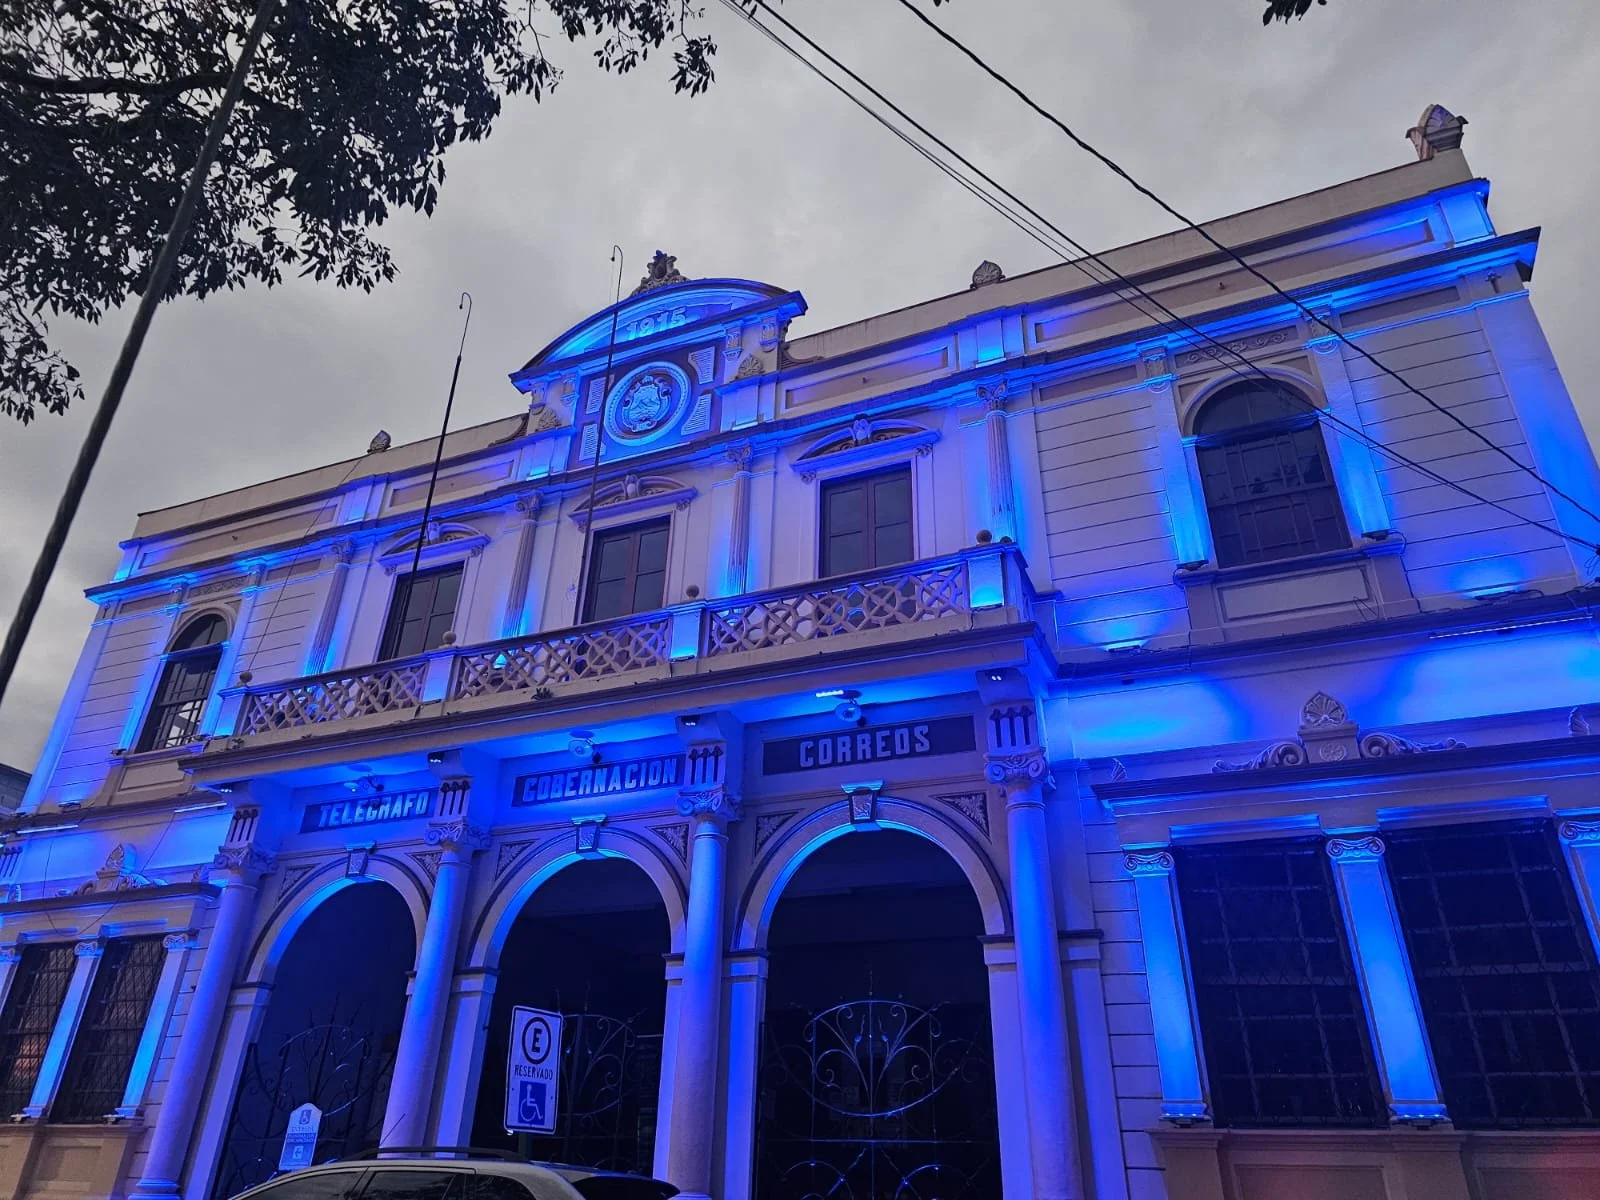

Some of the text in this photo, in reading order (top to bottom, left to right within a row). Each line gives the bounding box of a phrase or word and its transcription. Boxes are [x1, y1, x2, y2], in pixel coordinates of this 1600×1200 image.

[627, 306, 687, 340] 1915
[799, 724, 931, 768] CORREOS
[523, 758, 678, 802] GOBERNACION
[318, 791, 430, 828] TELEGRAFO
[531, 1027, 542, 1053] E
[514, 1064, 553, 1080] RESERVADO
